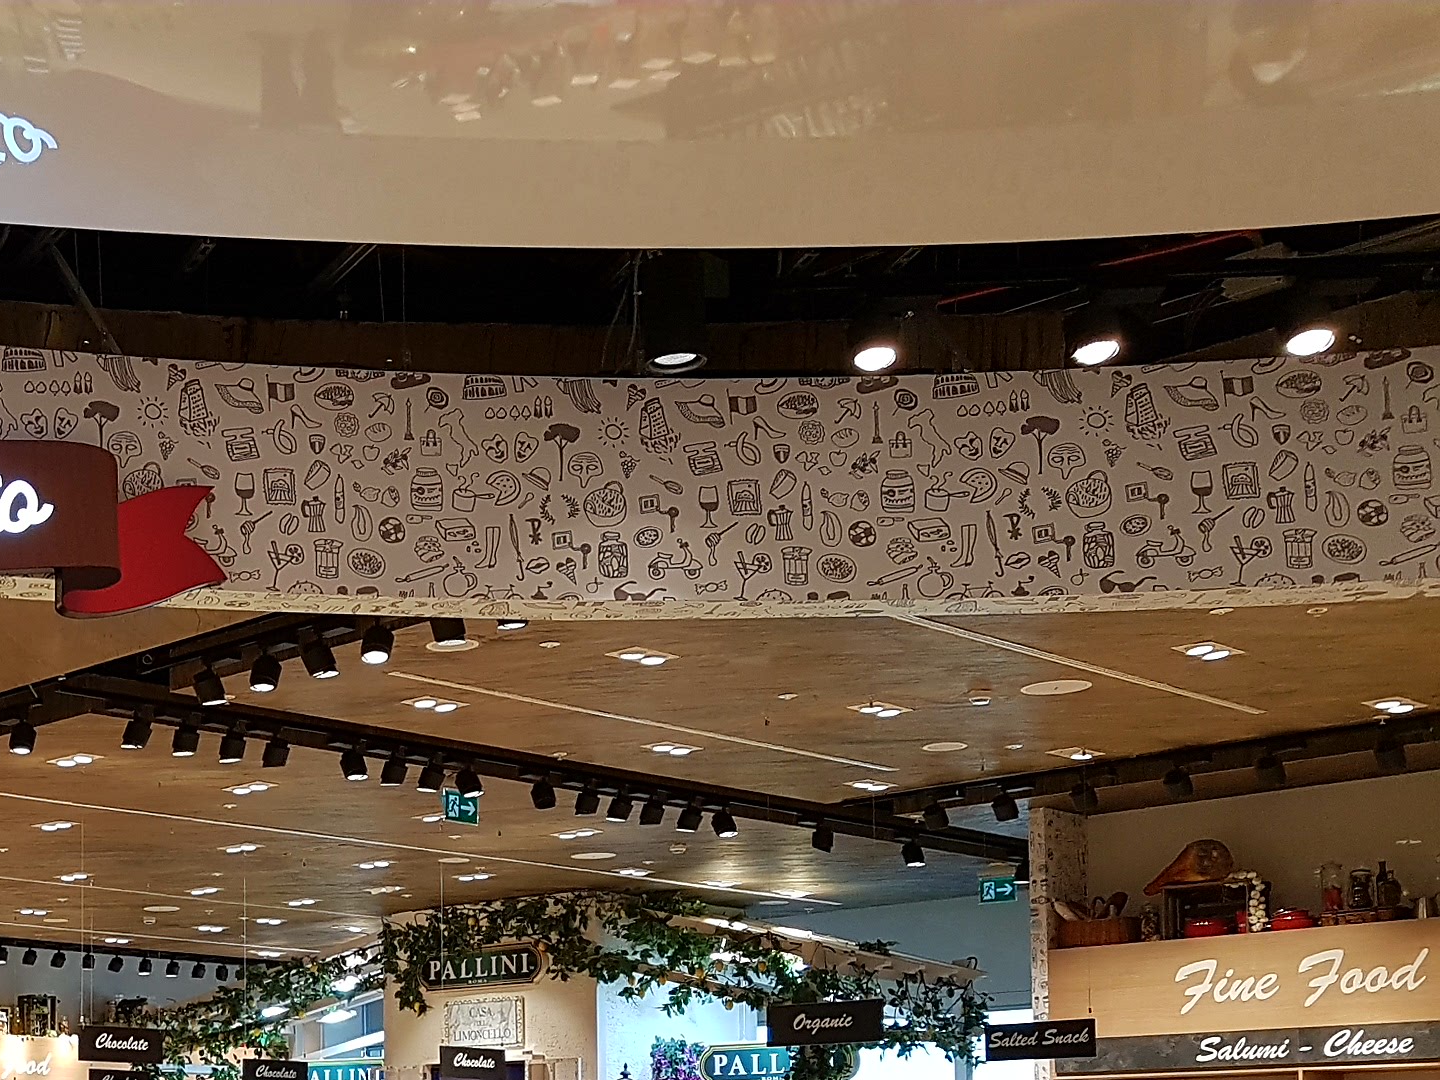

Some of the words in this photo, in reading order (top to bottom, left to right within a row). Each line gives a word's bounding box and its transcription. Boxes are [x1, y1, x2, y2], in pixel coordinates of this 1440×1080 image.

[428, 952, 530, 981] PALLINI
[1173, 957, 1280, 1015] Fine
[1298, 947, 1430, 1008] Food
[468, 1006, 492, 1019] CASA
[792, 1012, 854, 1032] Organic
[95, 1032, 149, 1052] Chocolate
[453, 1028, 511, 1042] LIMONCELLO
[989, 1029, 1039, 1049] Salted
[1041, 1026, 1089, 1047] Snack
[1196, 1036, 1290, 1064] Salumi
[1323, 1029, 1415, 1059] Cheese
[453, 1053, 496, 1069] Chocolate
[713, 1053, 786, 1076] PALL
[255, 1065, 297, 1080] Chocolate
